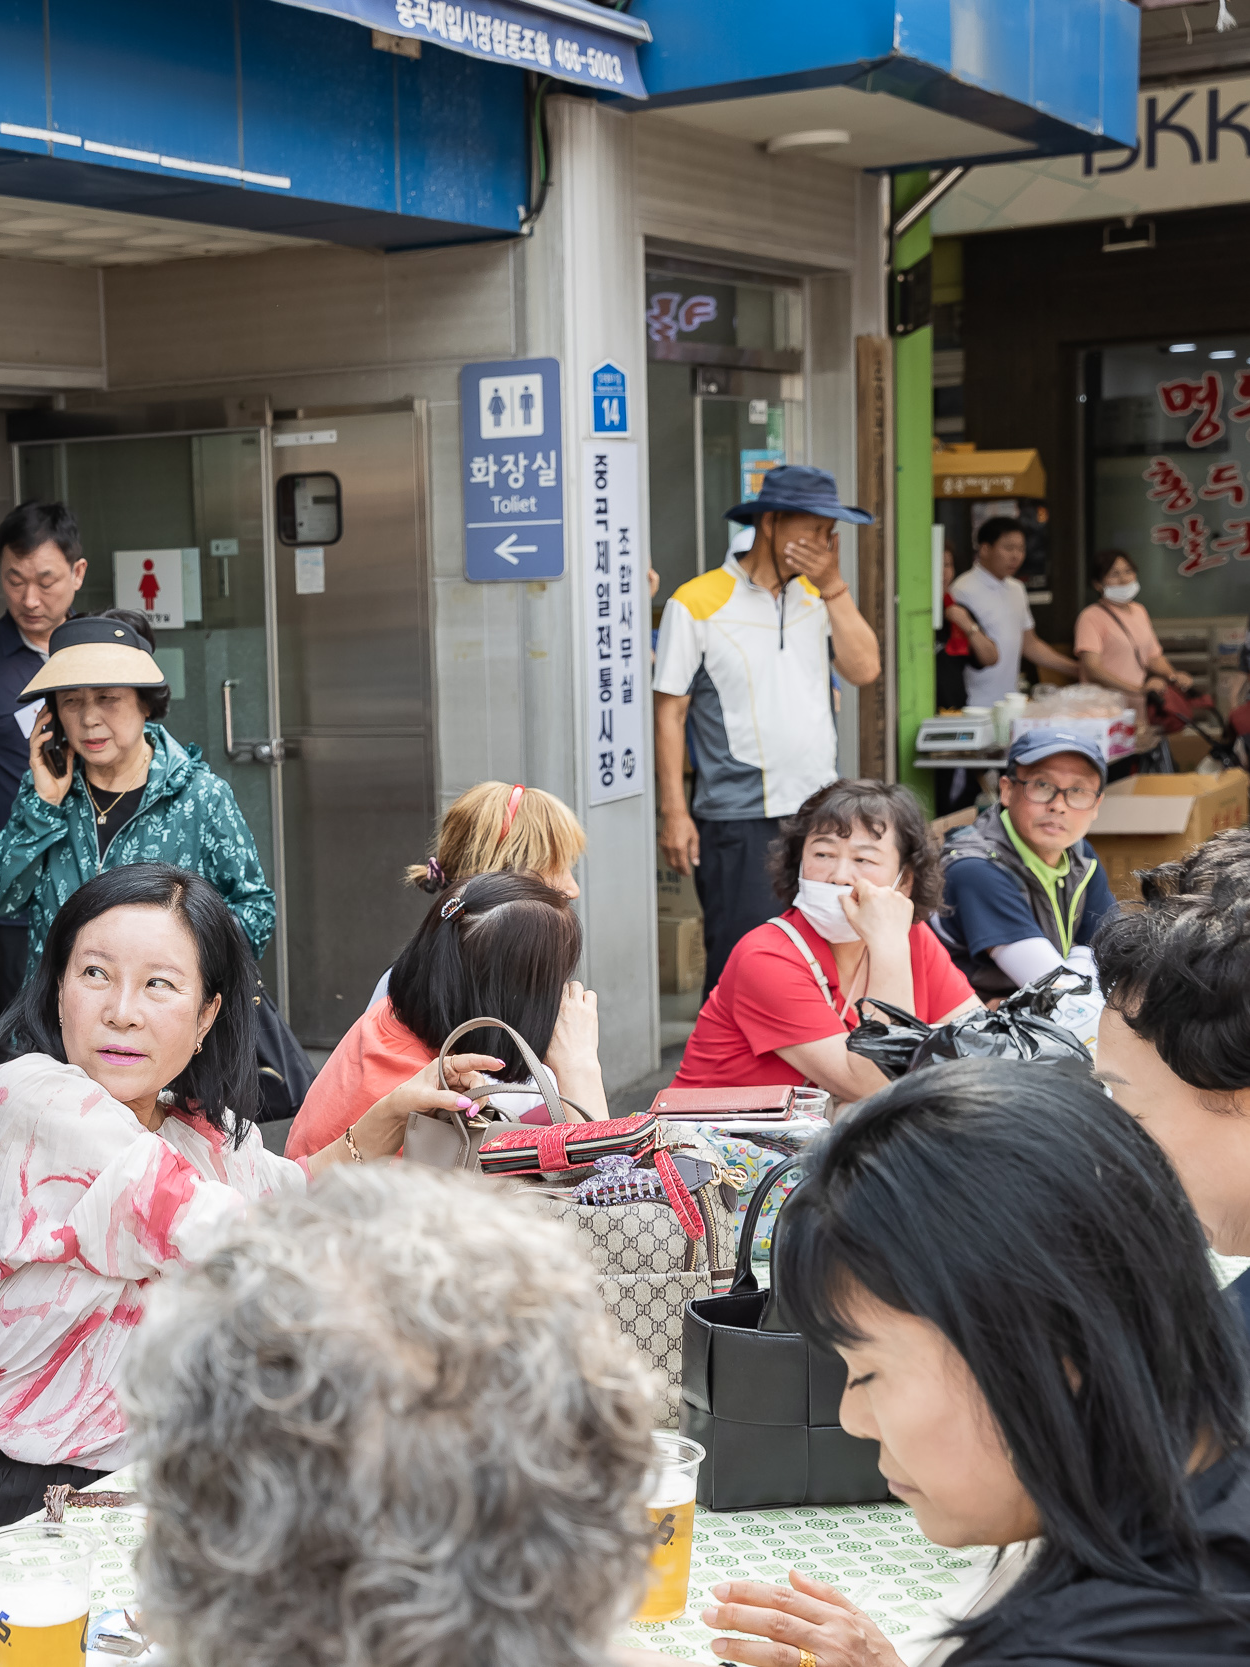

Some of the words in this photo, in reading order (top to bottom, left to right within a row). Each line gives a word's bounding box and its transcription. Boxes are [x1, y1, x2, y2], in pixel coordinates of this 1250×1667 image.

[555, 38, 624, 84] 466-5003
[601, 397, 621, 427] 14
[469, 450, 558, 489] 화장실
[593, 454, 615, 787] 중곡제일전통시장
[618, 527, 634, 704] 조합사무실
[609, 1218, 624, 1231] GD
[639, 1221, 654, 1233] GD
[608, 1252, 623, 1265] GD
[638, 1254, 653, 1267] GD
[669, 1256, 684, 1269] GD
[636, 1303, 651, 1316] GD
[666, 1303, 682, 1317] GD
[636, 1337, 652, 1350] GD
[667, 1337, 682, 1351] GD
